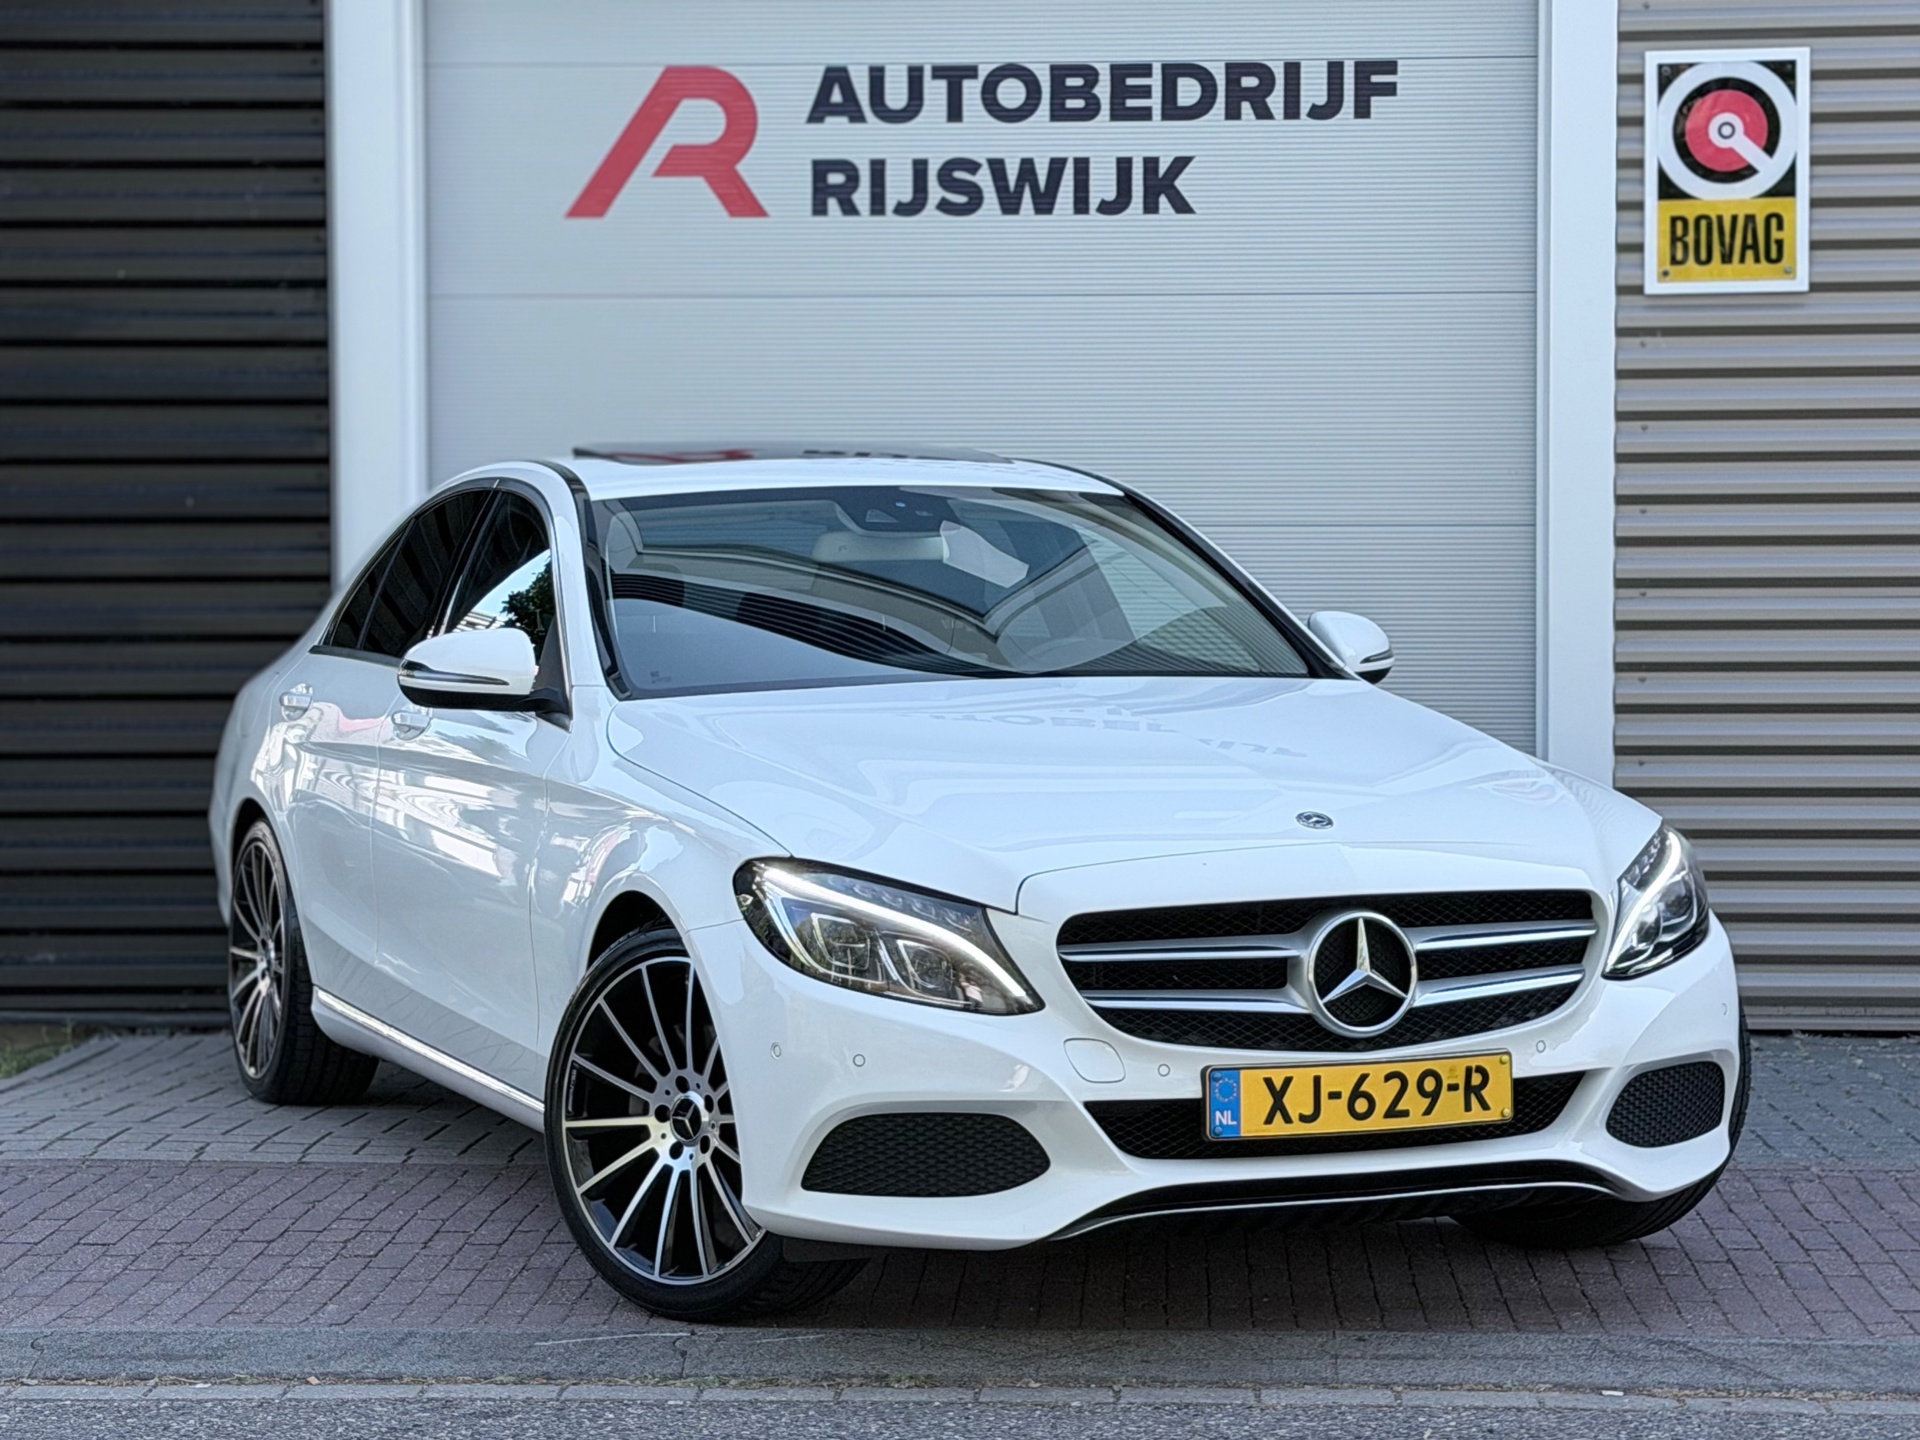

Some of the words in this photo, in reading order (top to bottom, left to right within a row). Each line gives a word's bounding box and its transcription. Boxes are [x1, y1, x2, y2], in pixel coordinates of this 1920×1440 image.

[805, 60, 1399, 124] AUTOBEDRIJF
[810, 156, 1198, 217] RIJSWIJK
[1669, 212, 1785, 267] BOVAG
[1215, 1110, 1238, 1126] NL
[1262, 1064, 1492, 1126] XJ-629-R
